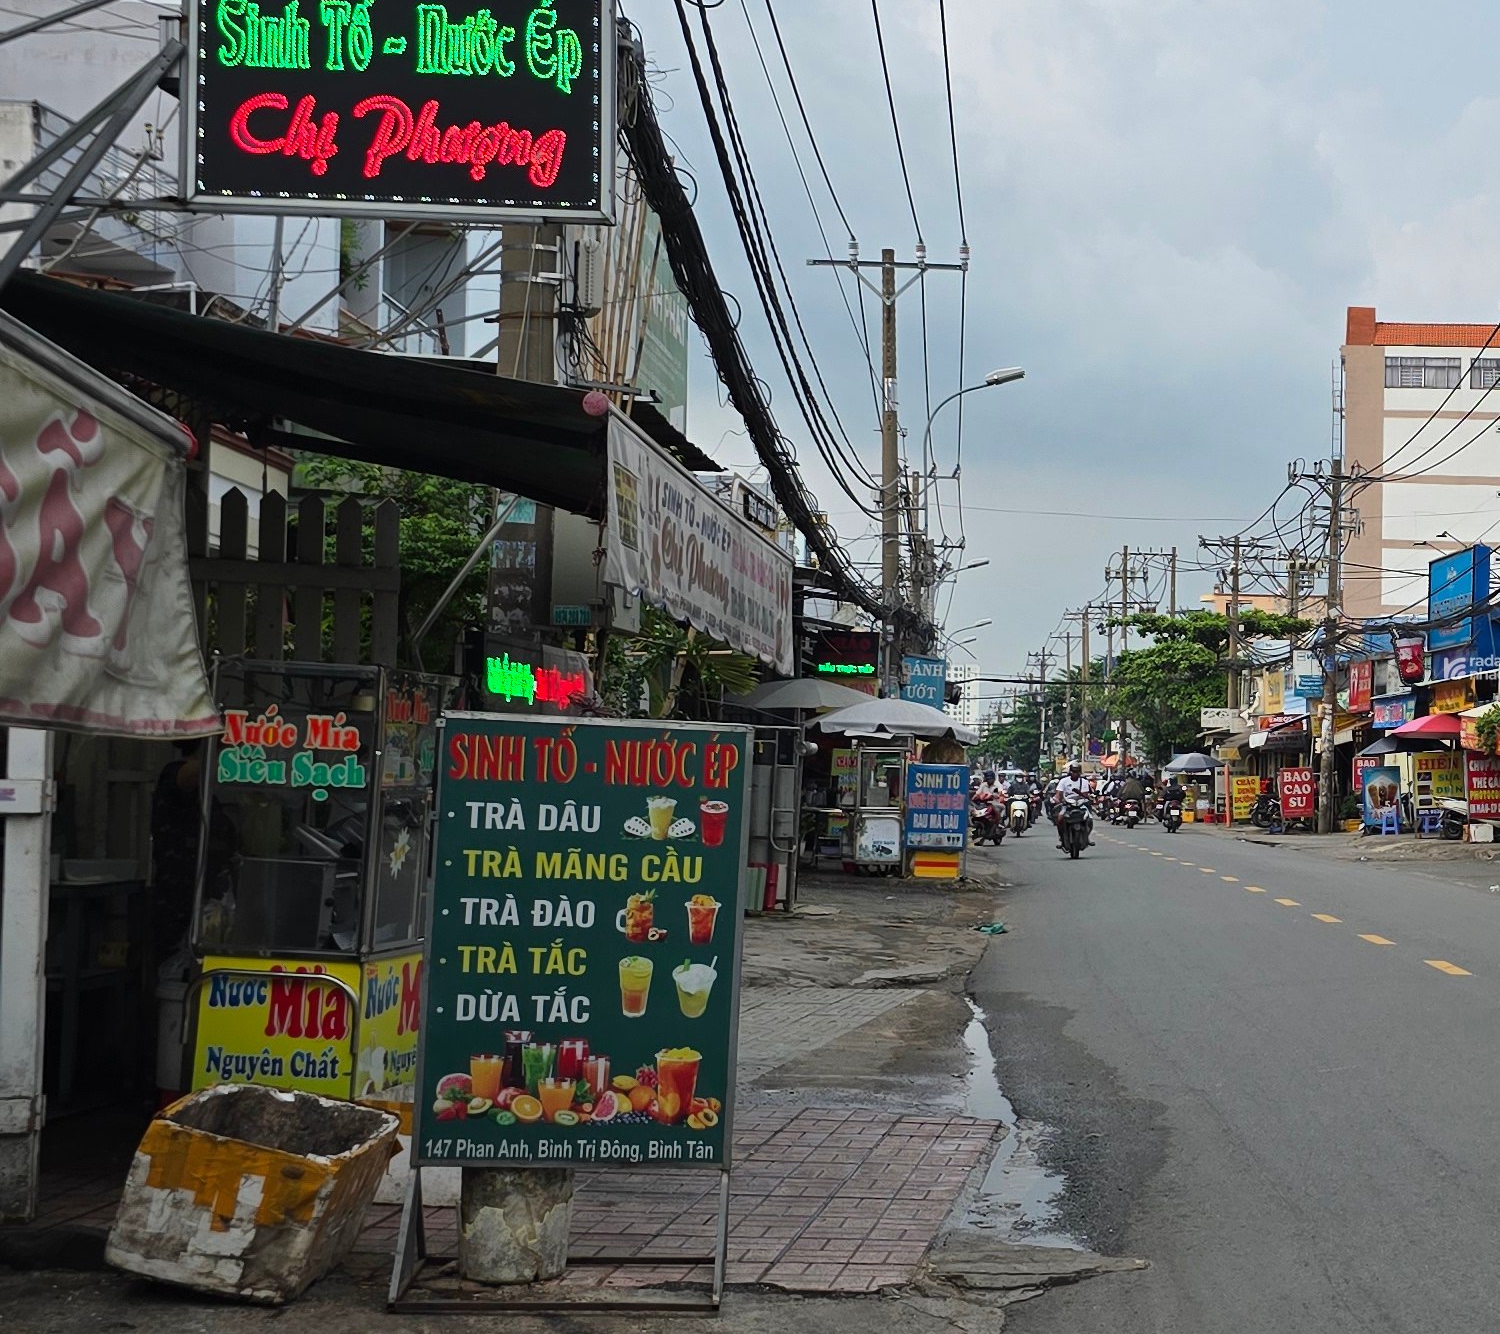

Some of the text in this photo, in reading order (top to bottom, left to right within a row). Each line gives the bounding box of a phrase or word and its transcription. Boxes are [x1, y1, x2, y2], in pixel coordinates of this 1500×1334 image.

[230, 92, 567, 187] Chị Phượng
[221, 703, 361, 751] Nước Mía
[449, 732, 526, 783] SINH
[533, 725, 578, 784] TỐ
[604, 731, 697, 788] NƯỚC
[703, 732, 739, 788] ÉP
[291, 750, 367, 801] Sạch
[914, 772, 944, 789] SINH
[1283, 770, 1312, 783] BAO
[1283, 783, 1312, 795] CAO
[466, 797, 601, 833] TRÀ DÂU
[1288, 796, 1307, 808] SU
[463, 845, 703, 884] TRÀ MÃNG CẦU
[460, 893, 596, 928] TRÀ ĐÀO
[457, 938, 588, 976] TRÀ TẮC
[455, 989, 521, 1023] DỪA
[531, 986, 591, 1024] TẮC
[205, 1046, 340, 1081] Nguyên Chất
[425, 1138, 715, 1163] 147 Phan Anh, Bình Trị Đông, Bình Tân
